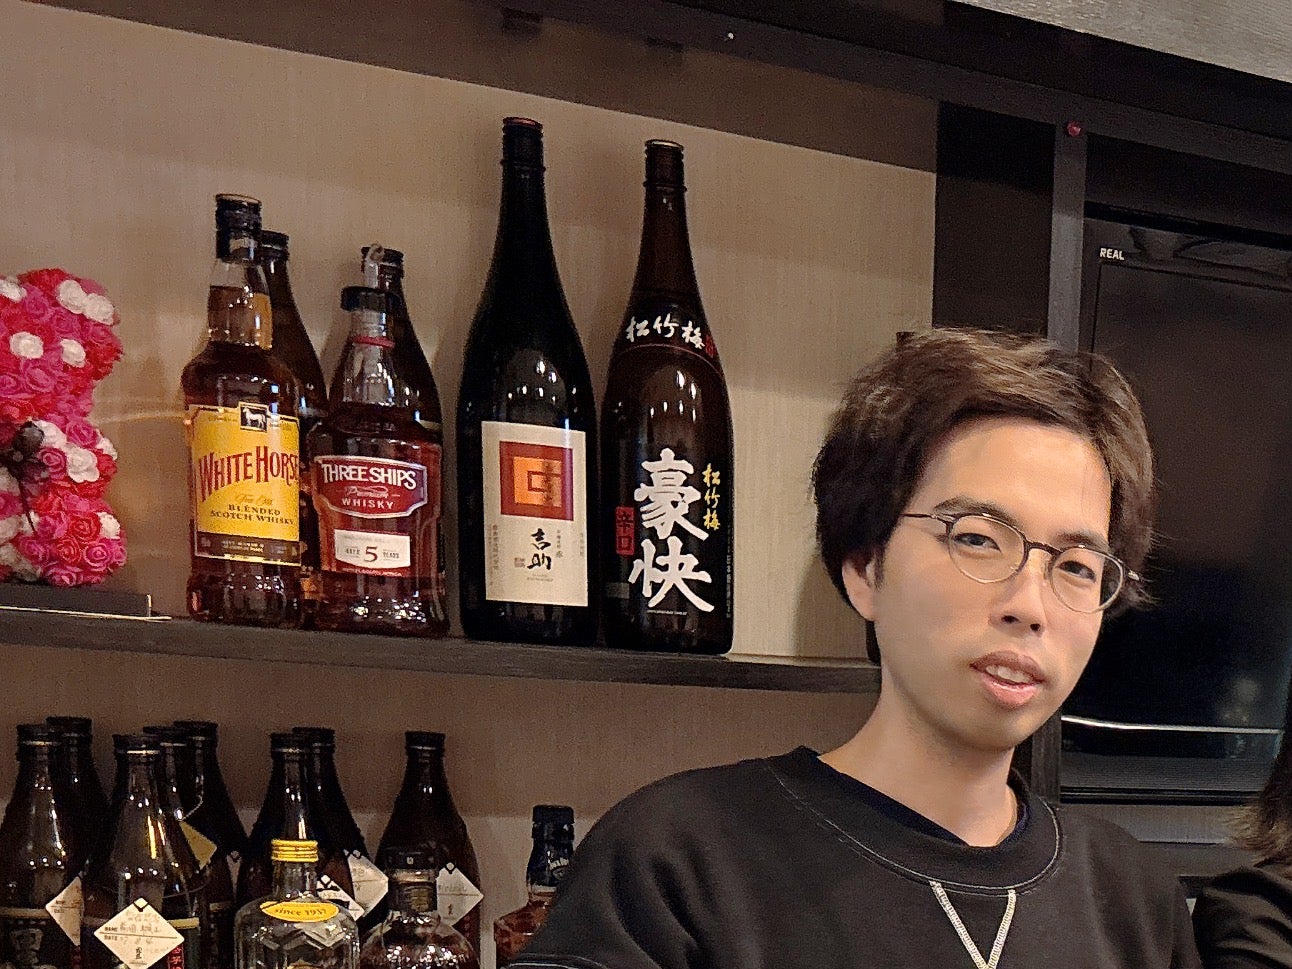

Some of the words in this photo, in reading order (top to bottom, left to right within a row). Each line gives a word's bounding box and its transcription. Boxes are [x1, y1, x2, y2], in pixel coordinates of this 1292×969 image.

[1100, 248, 1125, 261] REAL
[626, 313, 705, 350] 松竹梅
[199, 452, 253, 502] WHITE
[321, 463, 369, 484] THREE
[369, 467, 417, 490] SHIPS
[341, 498, 394, 510] WHISKY
[702, 463, 720, 531] 松竹梅
[210, 510, 252, 521] SCOTCH
[228, 504, 281, 516] BLENDED
[628, 448, 715, 613] 豪快
[363, 545, 379, 563] 5
